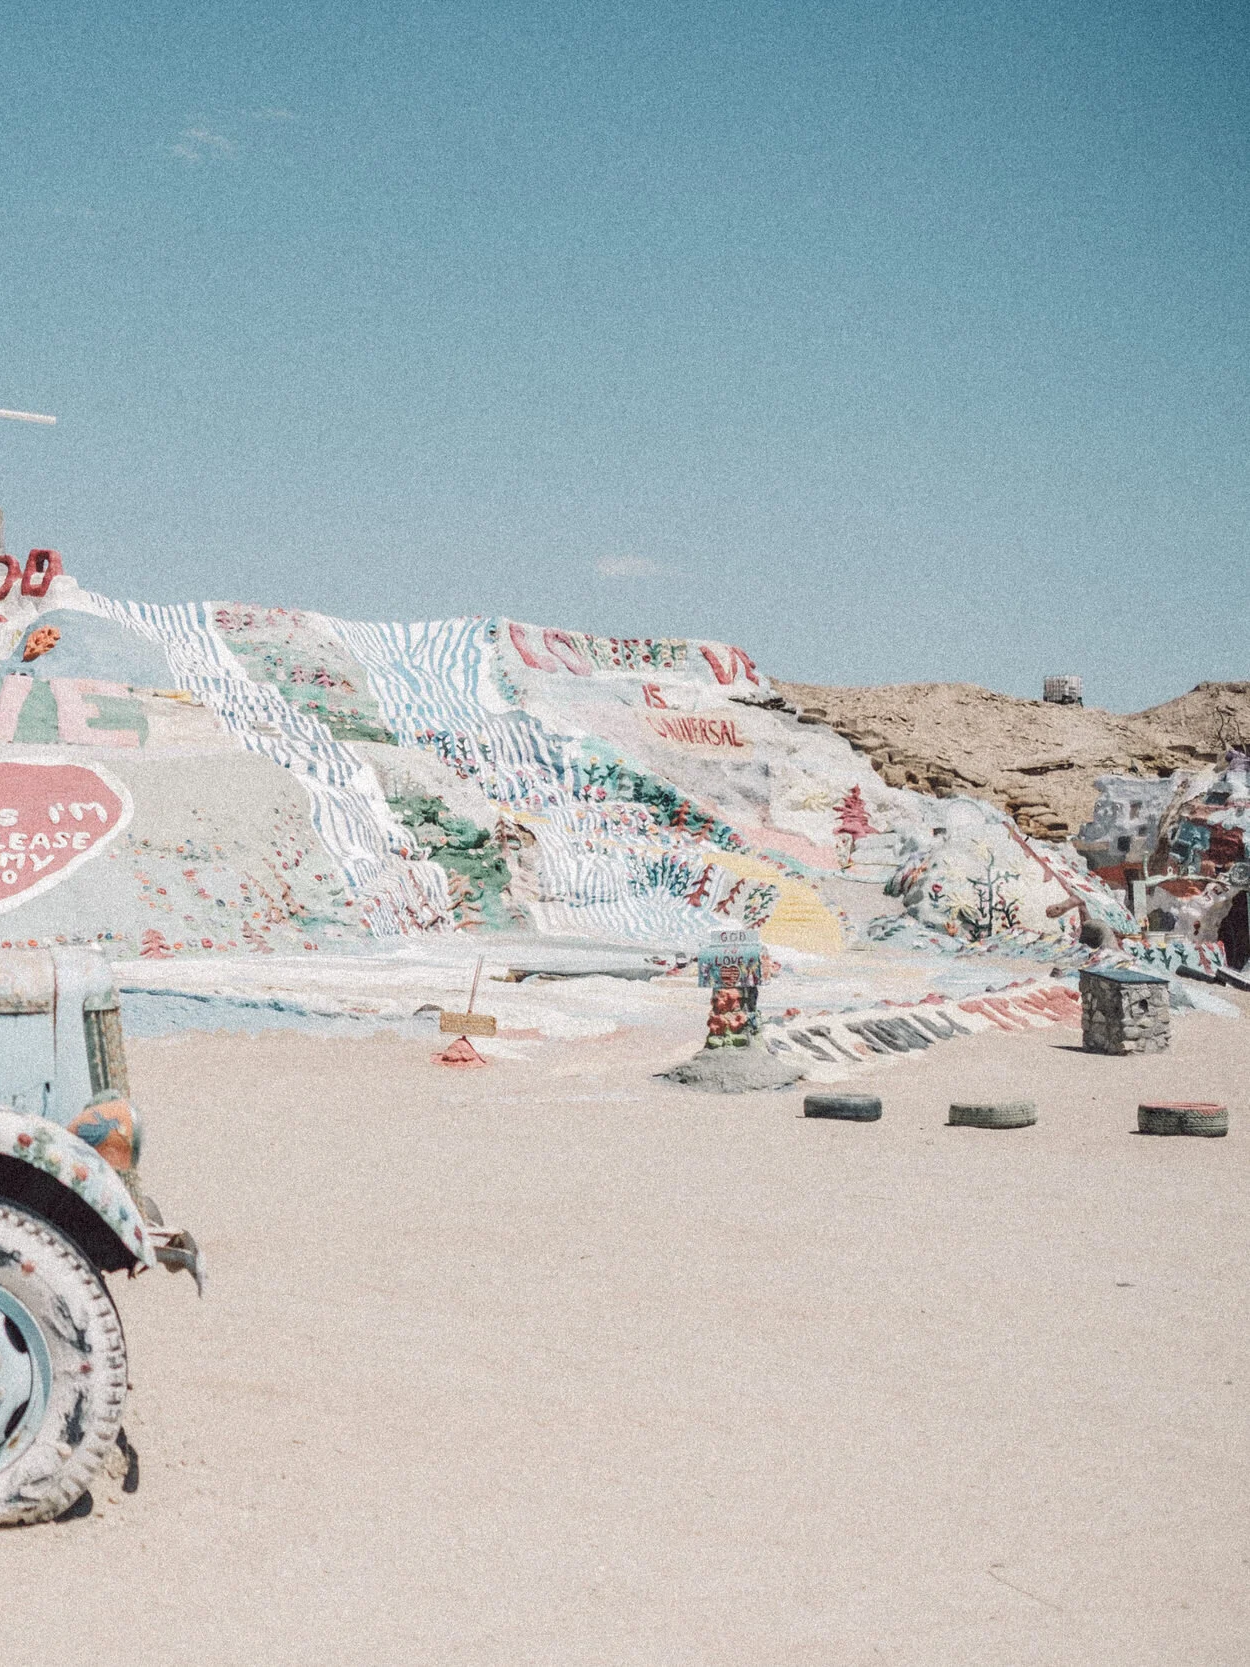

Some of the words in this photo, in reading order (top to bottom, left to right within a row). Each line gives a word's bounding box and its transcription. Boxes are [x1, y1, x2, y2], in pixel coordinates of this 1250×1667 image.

[641, 683, 668, 709] IS
[645, 715, 745, 747] UNIVERSAL
[720, 931, 746, 943] GOD
[715, 956, 744, 968] LOVE
